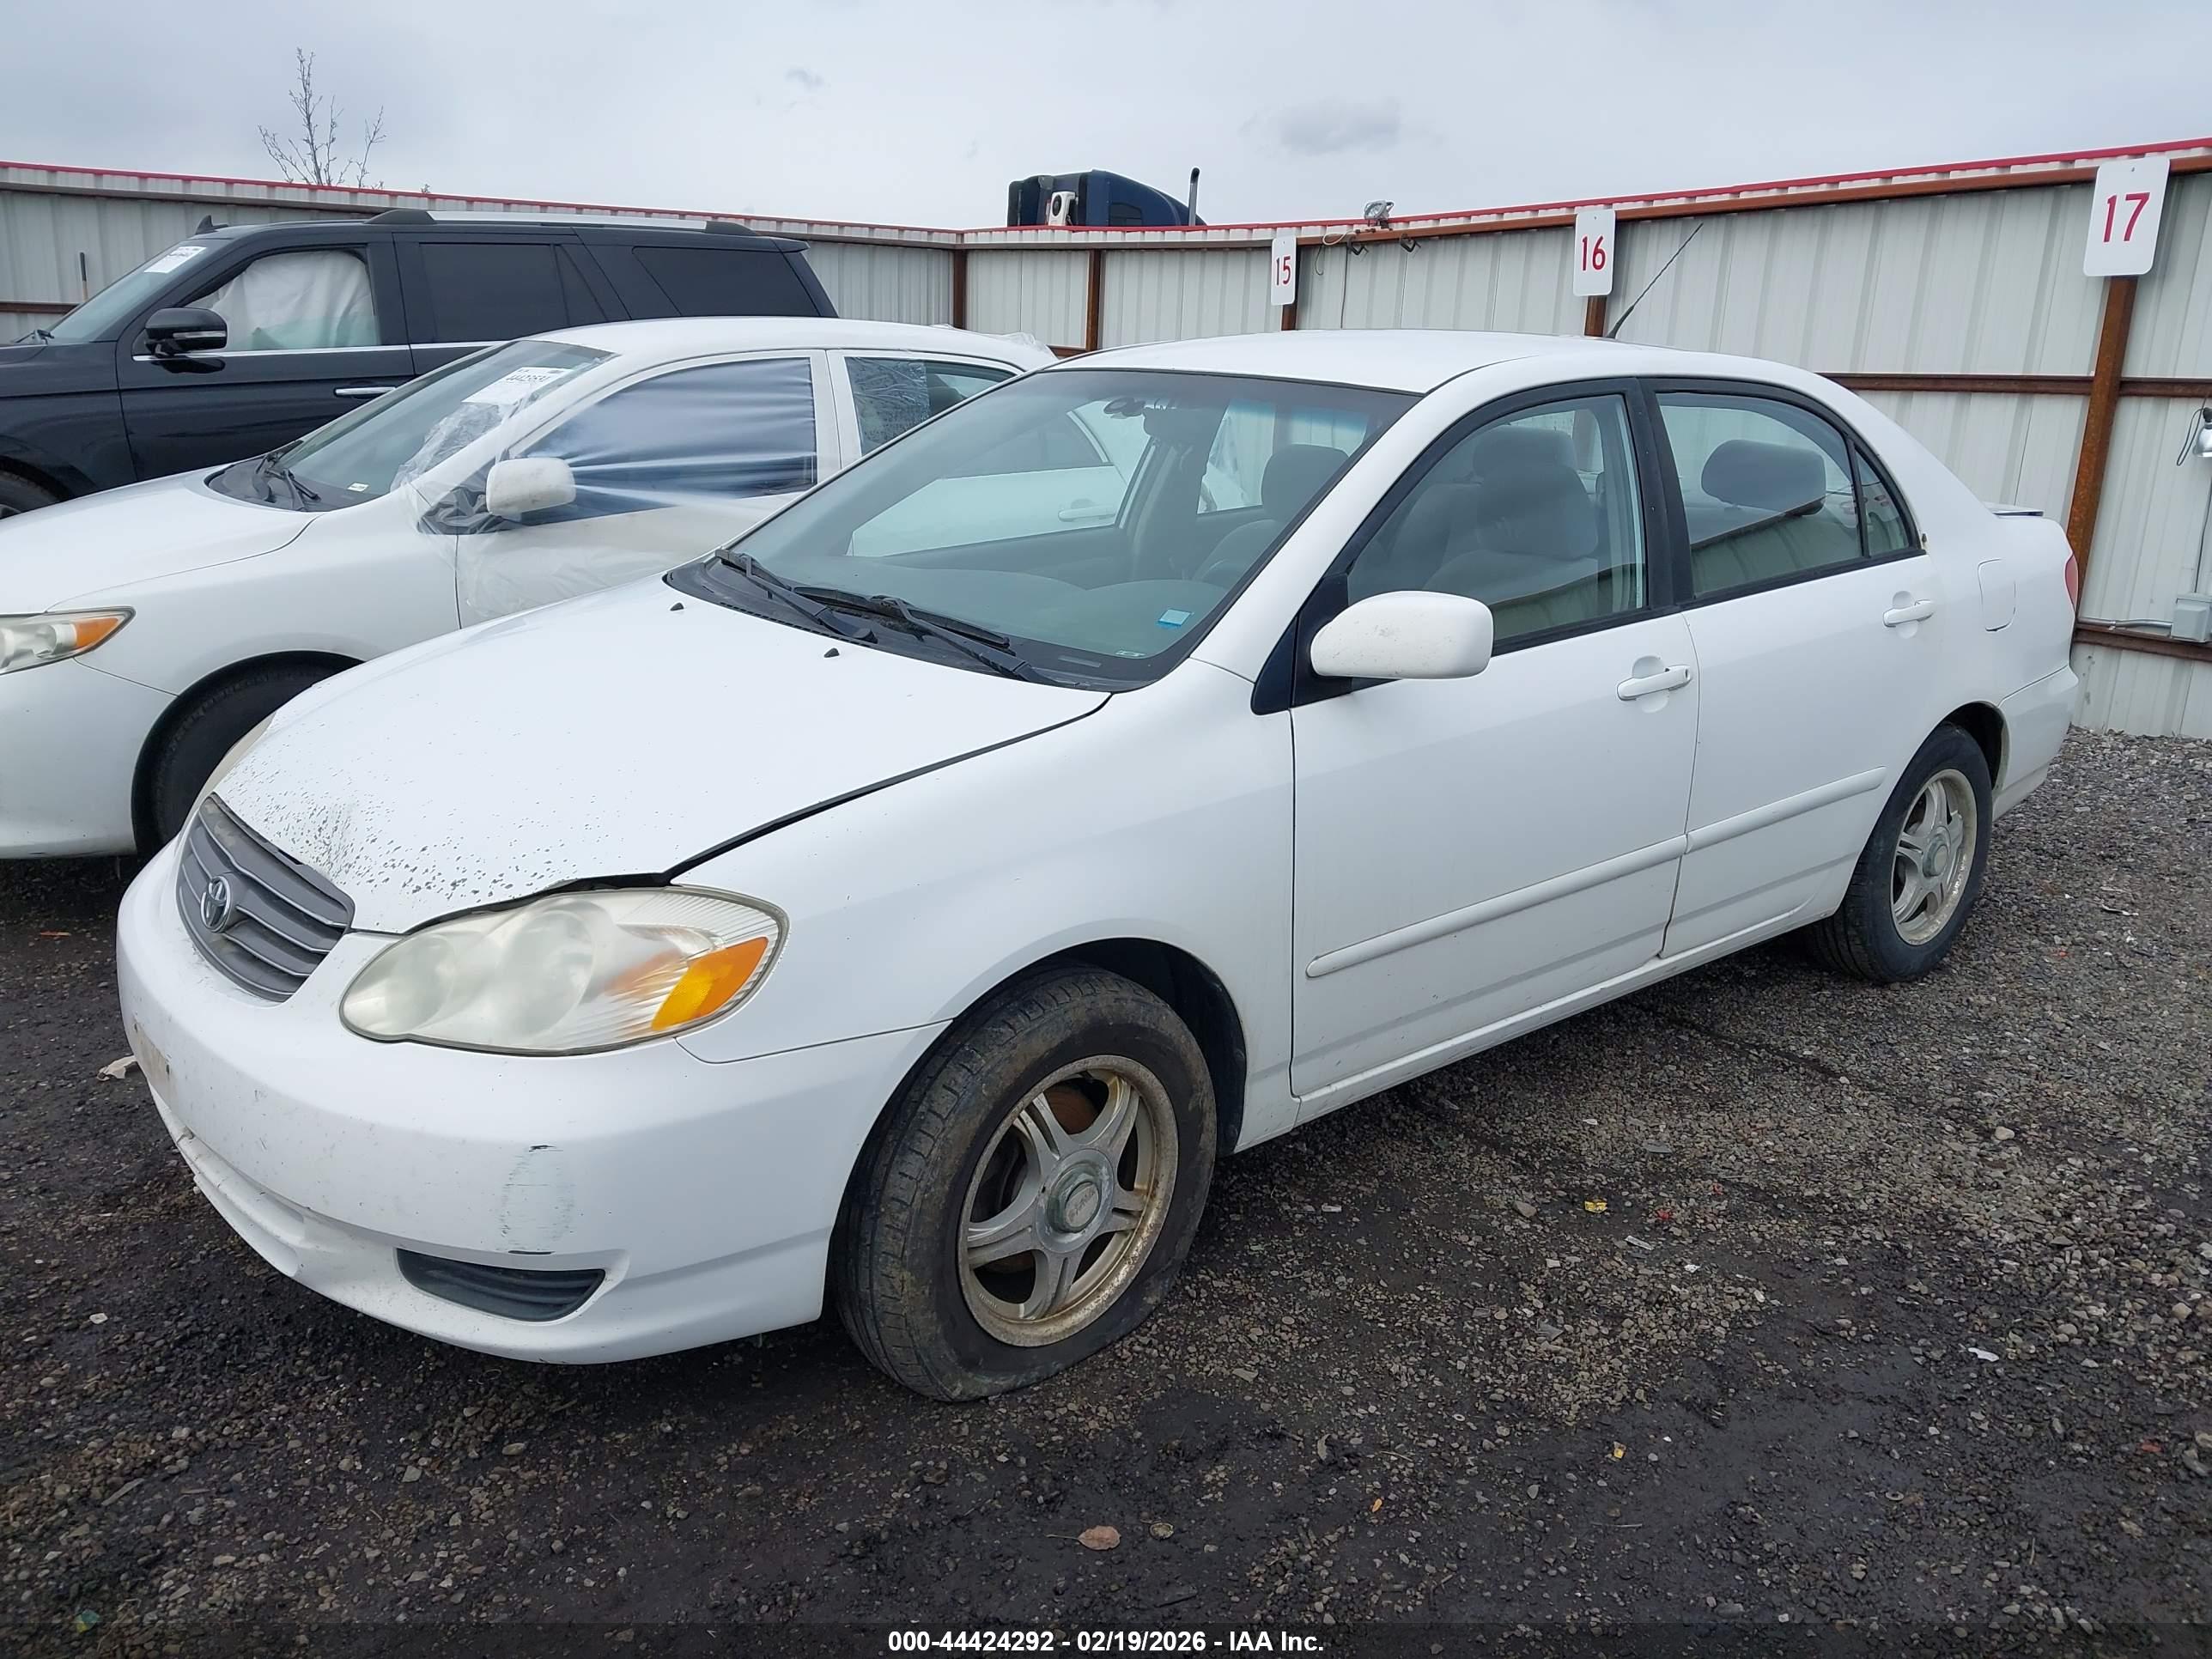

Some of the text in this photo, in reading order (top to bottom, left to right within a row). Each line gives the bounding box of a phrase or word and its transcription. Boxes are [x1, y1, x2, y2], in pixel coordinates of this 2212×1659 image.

[2103, 191, 2151, 243] 17
[1275, 256, 1291, 286] 15
[1582, 235, 1606, 271] 16
